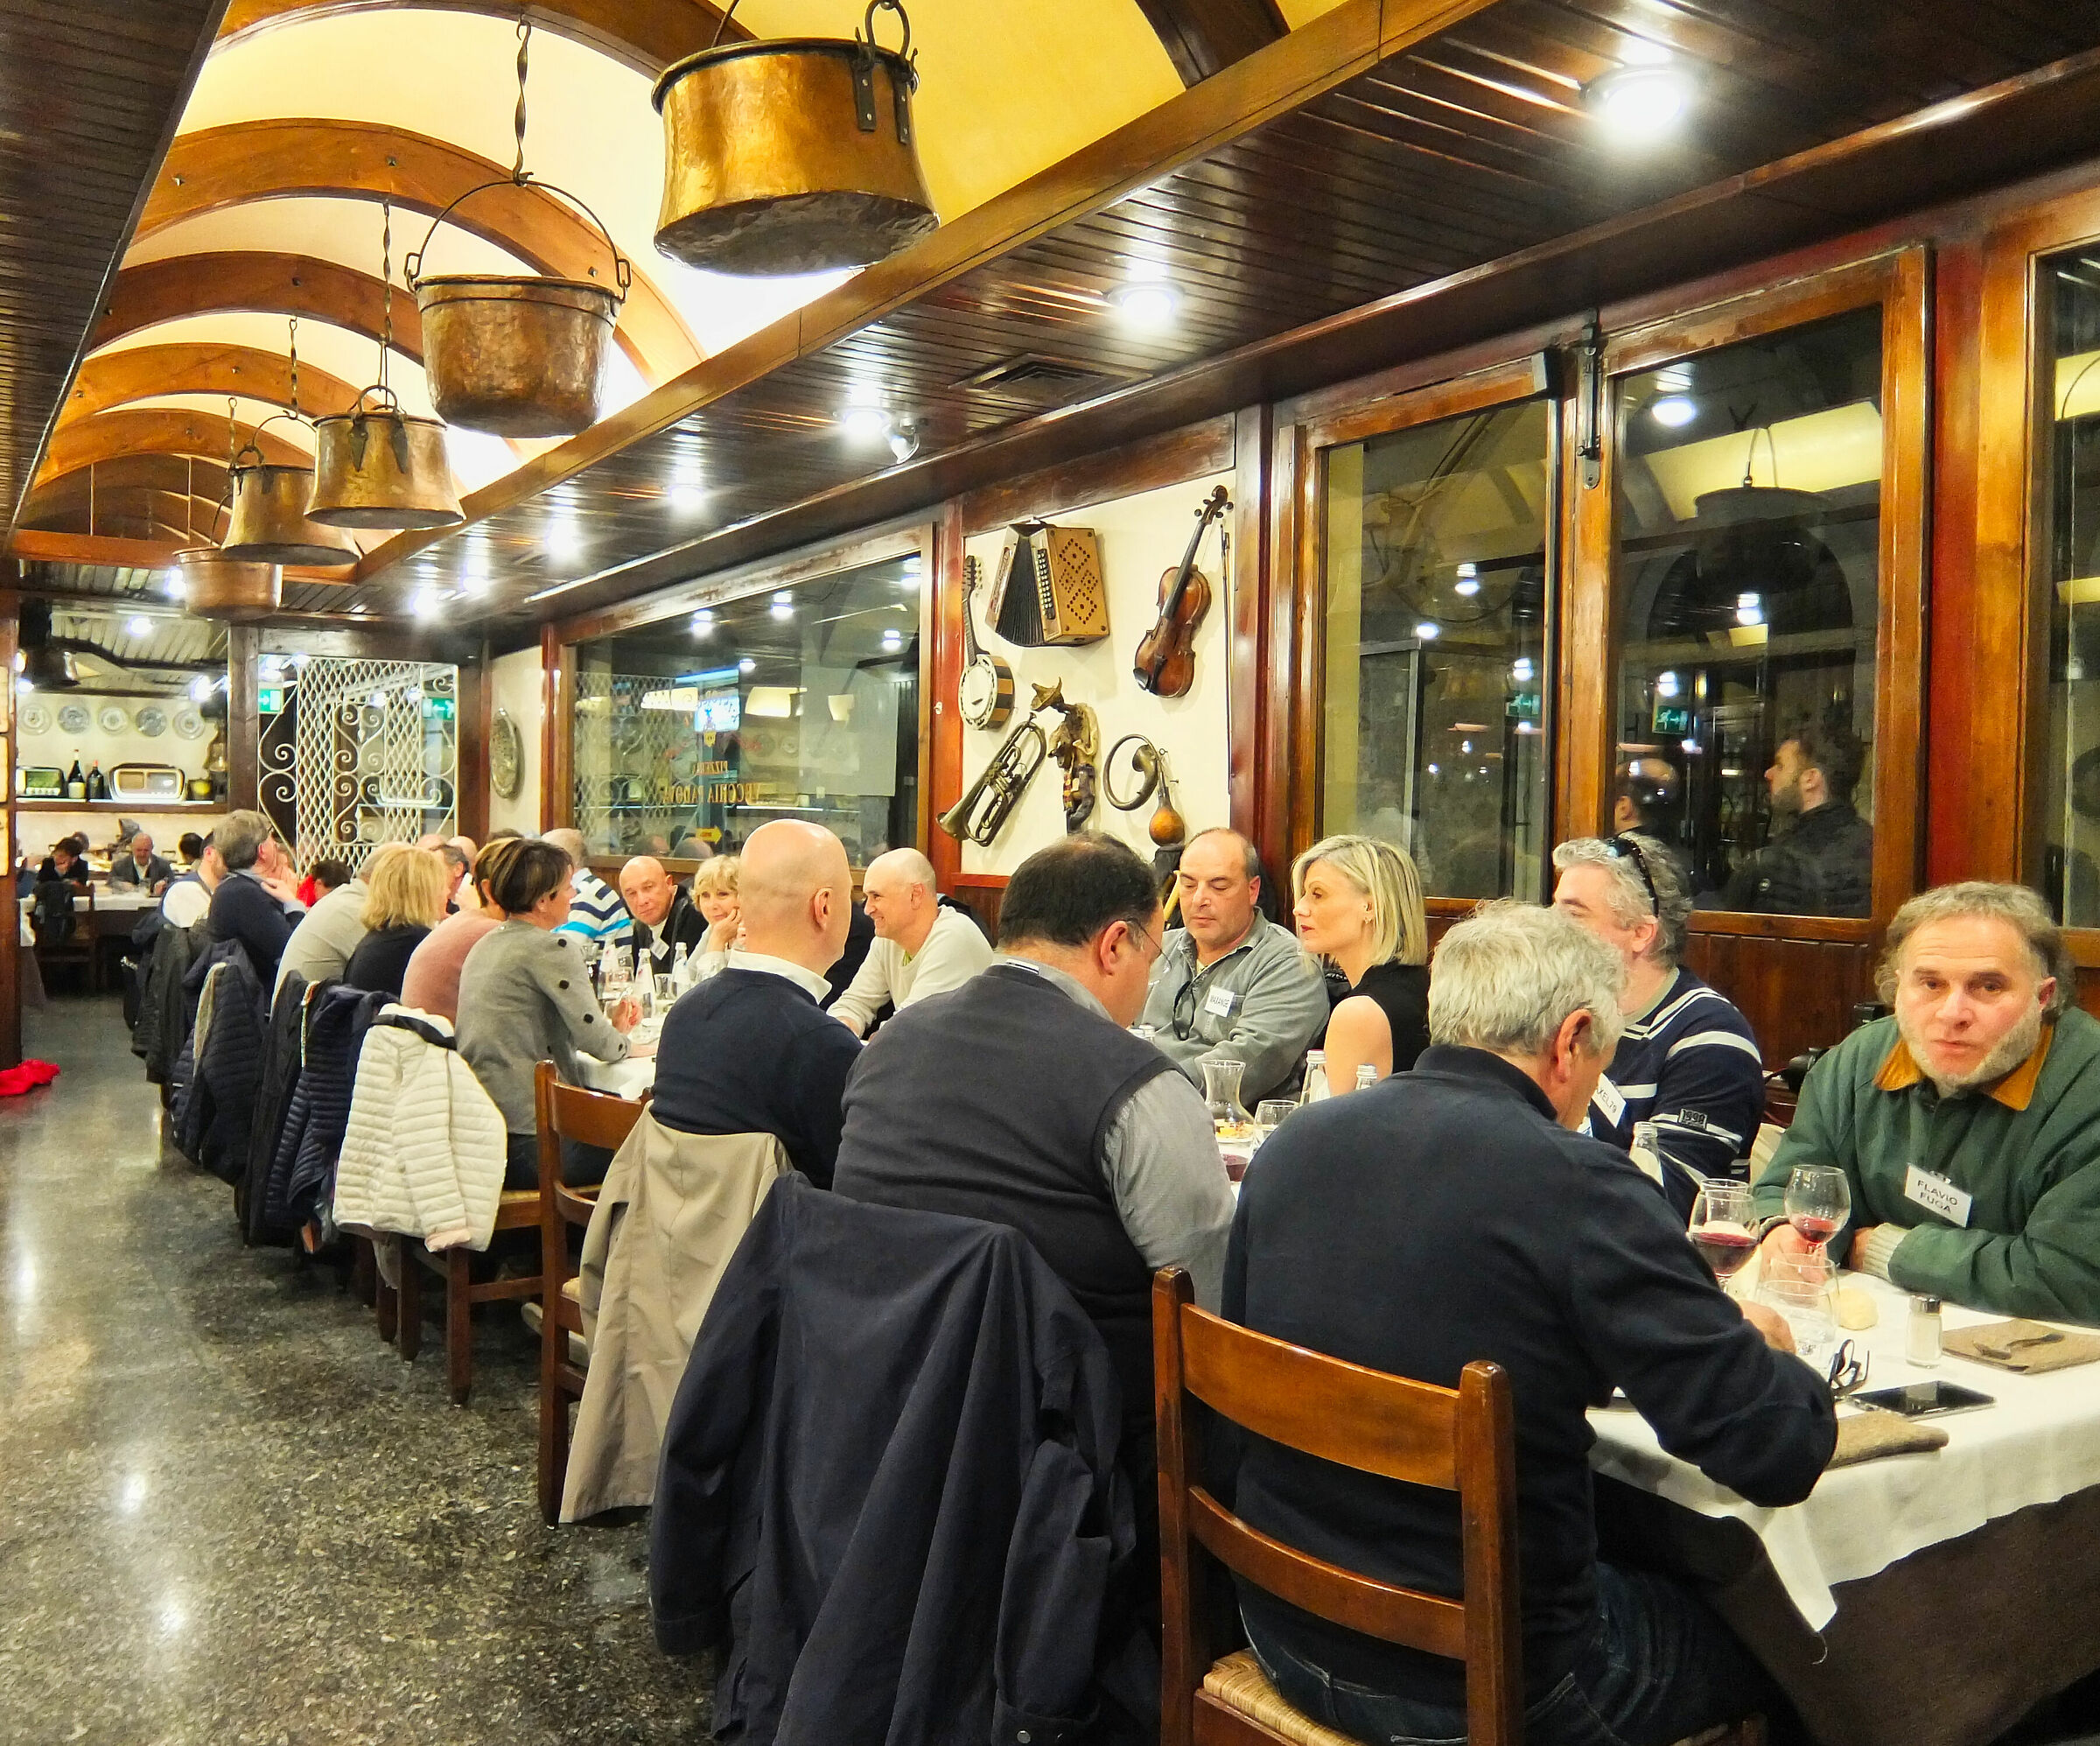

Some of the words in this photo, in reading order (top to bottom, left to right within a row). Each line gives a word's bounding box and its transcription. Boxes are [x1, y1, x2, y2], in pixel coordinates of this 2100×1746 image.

[1595, 1089, 1617, 1113] XEL79
[1917, 1180, 1957, 1205] FLAVIO
[1920, 1192, 1951, 1214] FUGA
